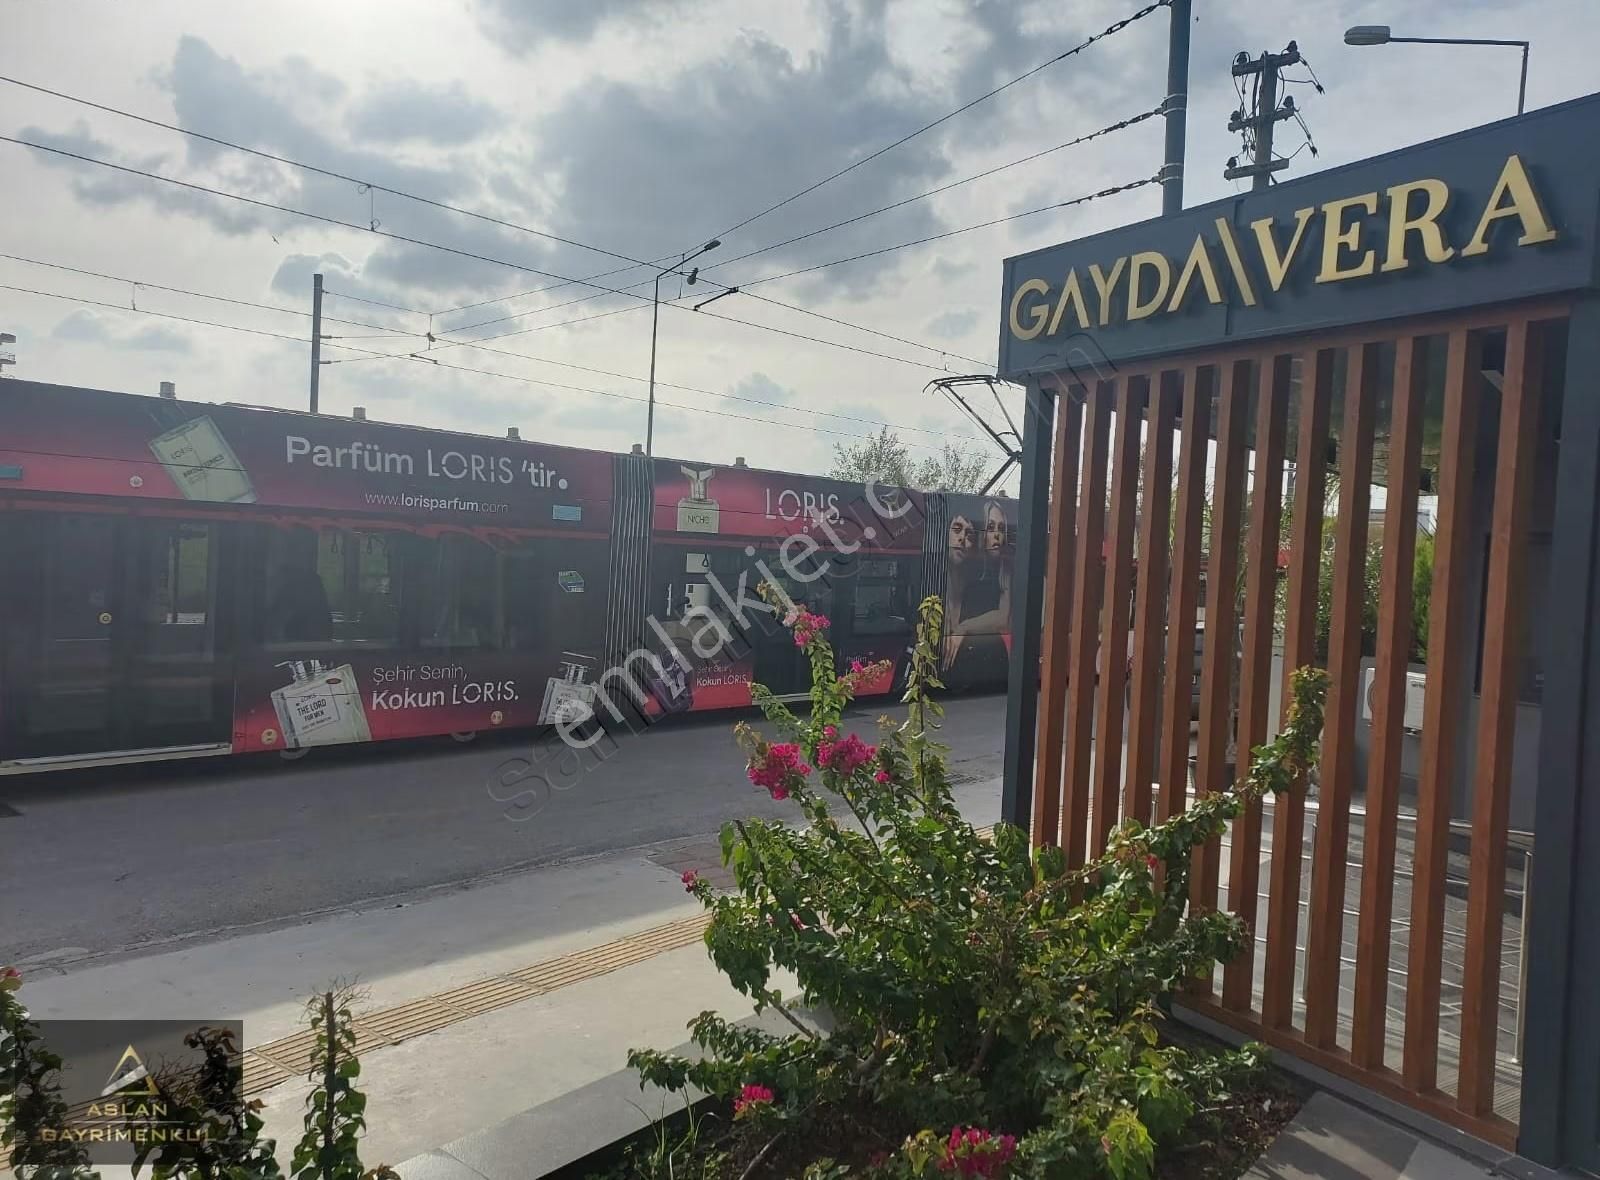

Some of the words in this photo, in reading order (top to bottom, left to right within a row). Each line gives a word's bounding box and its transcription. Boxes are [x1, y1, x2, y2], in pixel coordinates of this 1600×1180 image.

[286, 435, 414, 475] Parfüm
[428, 449, 514, 484] LORIS
[365, 491, 509, 514] www.lorisparfum.com
[372, 665, 416, 686] Şehir
[420, 663, 469, 682] Senin,
[696, 676, 722, 687] Kokun
[372, 686, 445, 711] Kokun
[452, 680, 519, 705] LORIS.
